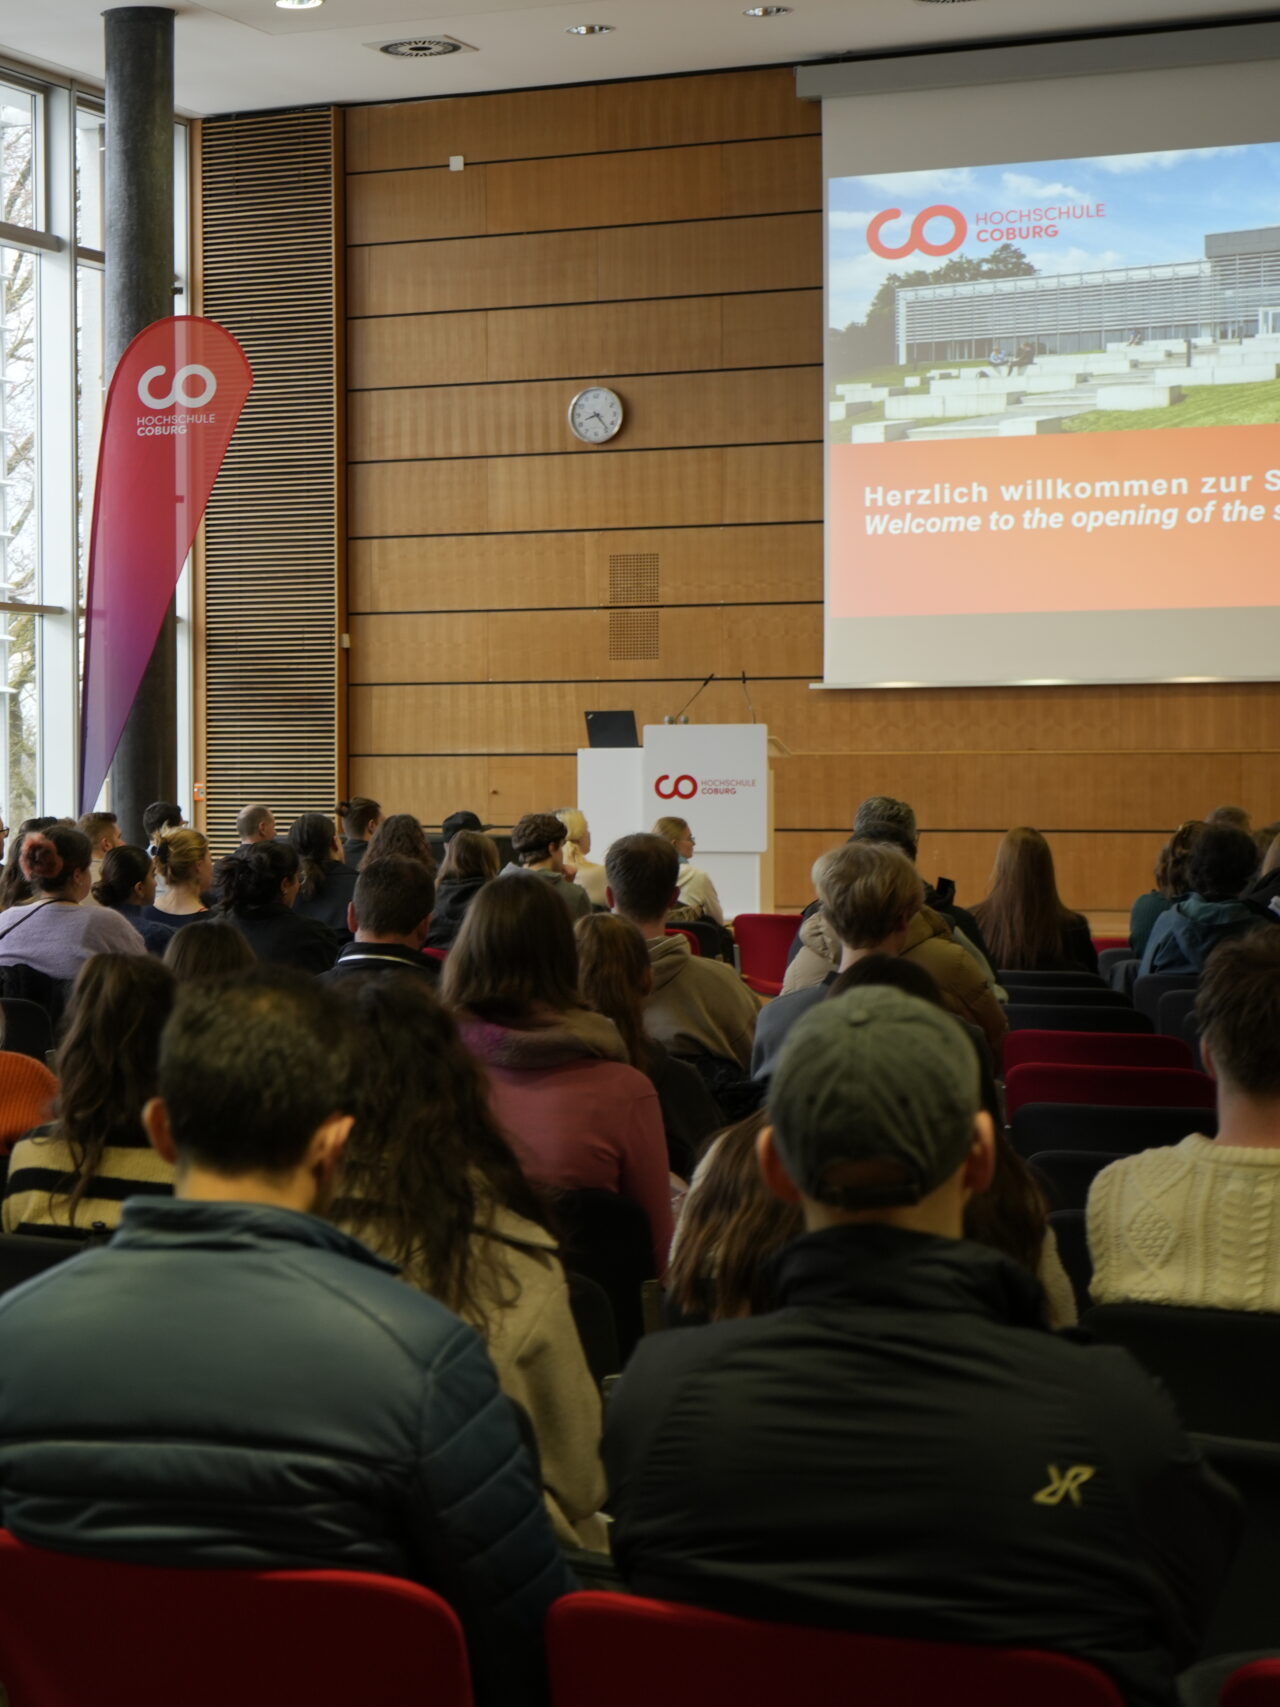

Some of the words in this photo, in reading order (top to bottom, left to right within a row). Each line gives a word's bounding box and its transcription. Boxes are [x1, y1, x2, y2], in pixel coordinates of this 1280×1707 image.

[975, 203, 1106, 226] HOCHSCHULE
[976, 224, 1059, 242] COBURG
[137, 414, 215, 425] HOCHSCHULE
[137, 425, 187, 436] COBURG
[864, 482, 989, 507] Herzlich
[1000, 477, 1189, 502] willkommen
[1200, 474, 1253, 494] zur
[864, 512, 983, 536] Welcome
[988, 511, 1015, 531] to
[1022, 507, 1065, 530] the
[1071, 503, 1180, 533] opening
[1185, 499, 1218, 524] of
[1221, 499, 1266, 523] the
[701, 779, 756, 787] HOCHSCHULE
[701, 787, 737, 795] COBURG
